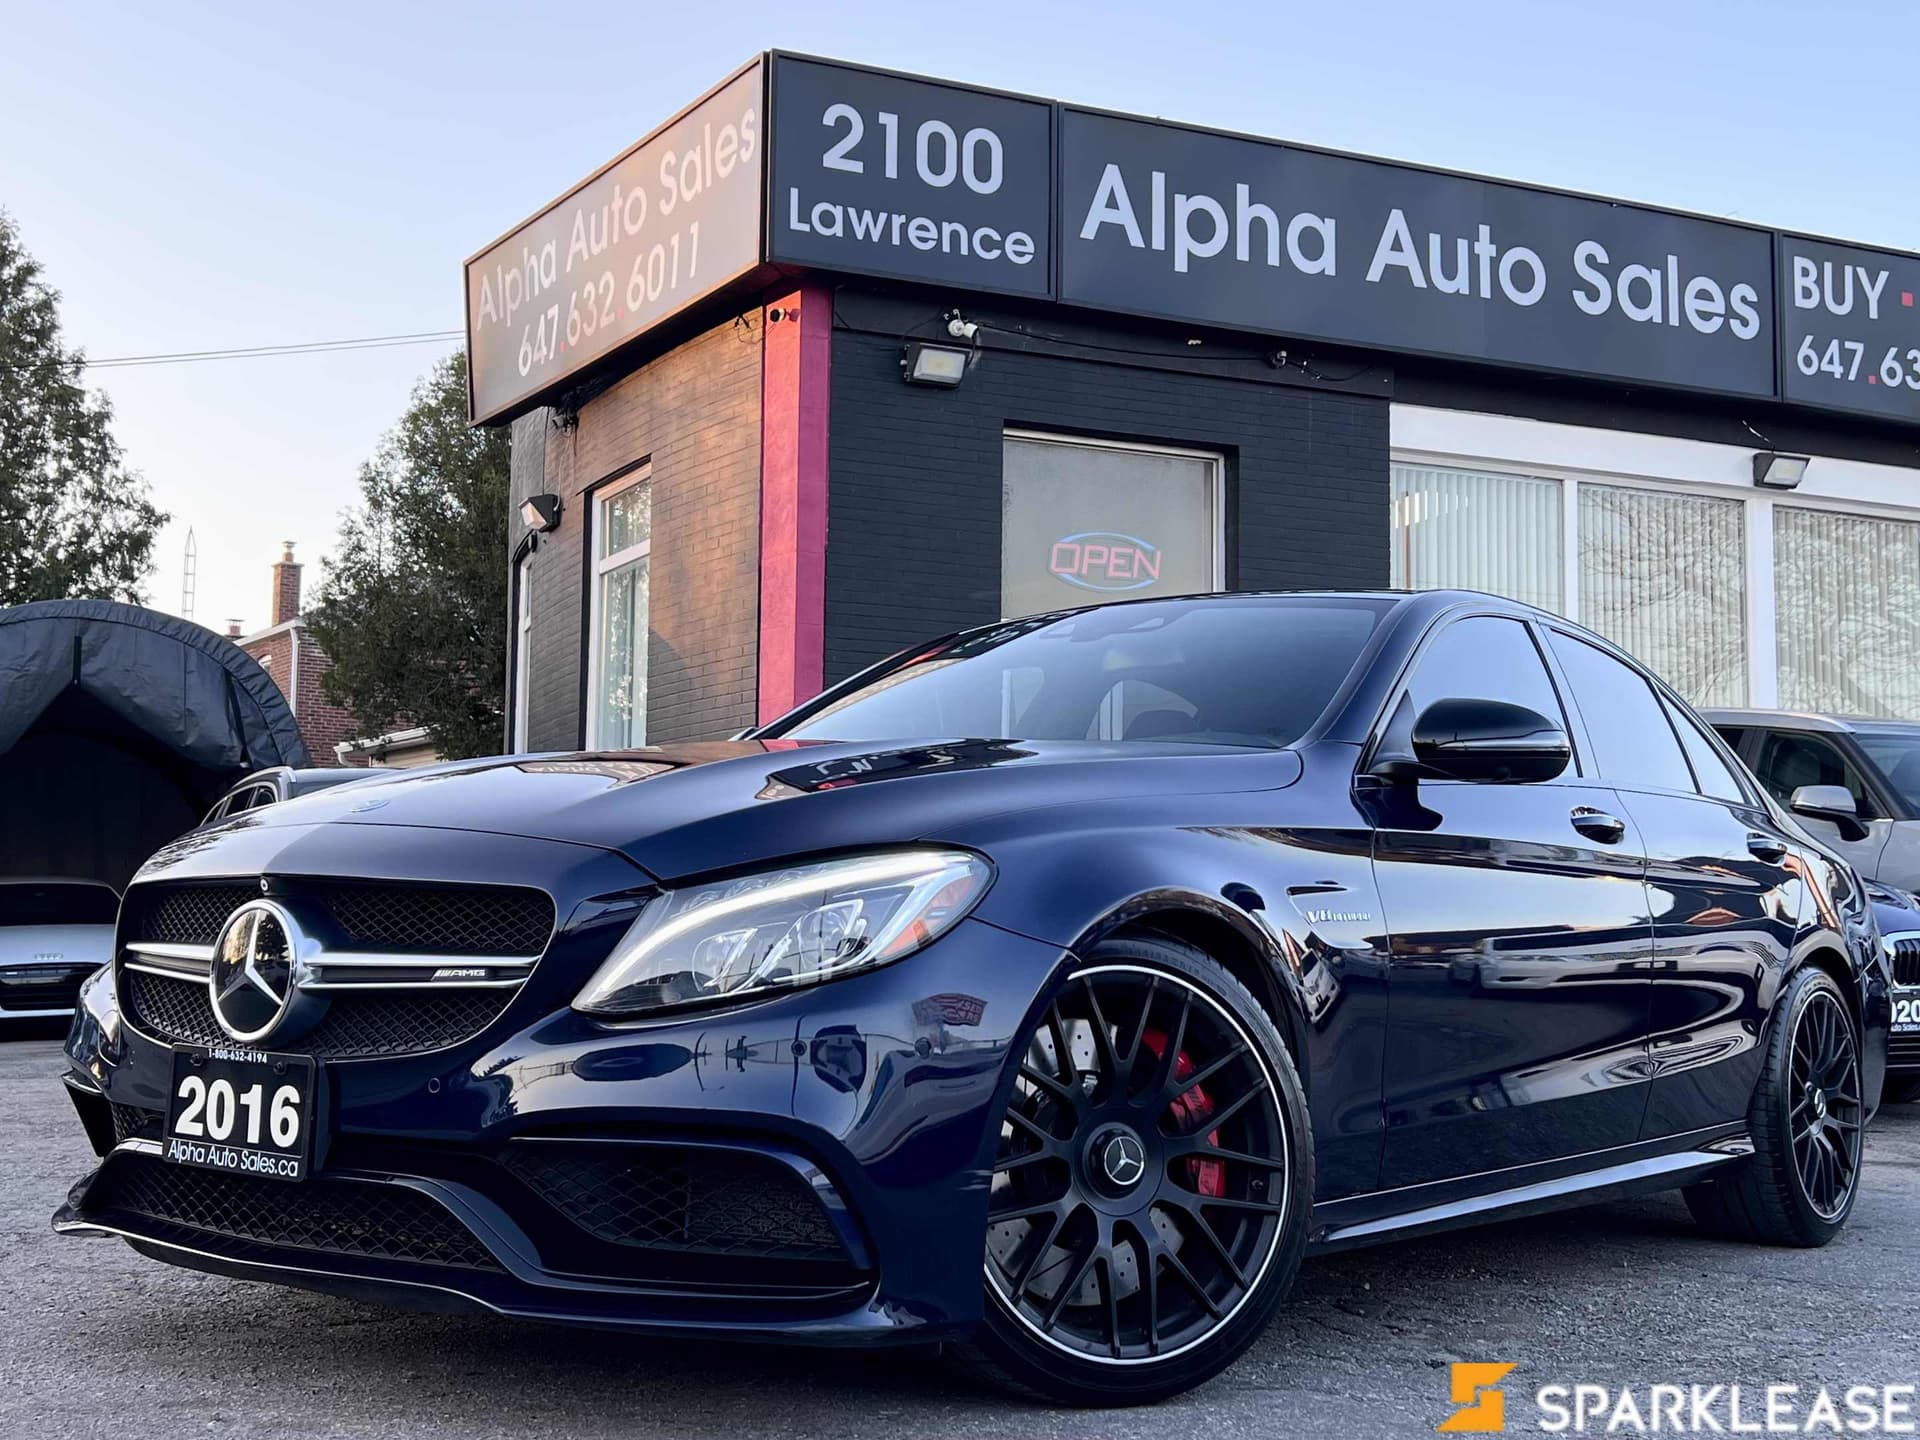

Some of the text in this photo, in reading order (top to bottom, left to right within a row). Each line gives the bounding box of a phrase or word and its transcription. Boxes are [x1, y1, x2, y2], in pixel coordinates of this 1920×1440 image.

[822, 102, 1003, 195] 2100
[477, 108, 755, 331] Alpha Auto Sales
[788, 186, 1036, 265] Lawrence
[1079, 163, 1761, 341] Alpha Auto Sales
[518, 221, 699, 376] 647.632.6011
[1793, 255, 1890, 319] BUY
[1051, 543, 1161, 579] OPEN
[175, 1075, 300, 1148] 2016
[167, 1139, 298, 1177] Alpha Auto Sales.ca
